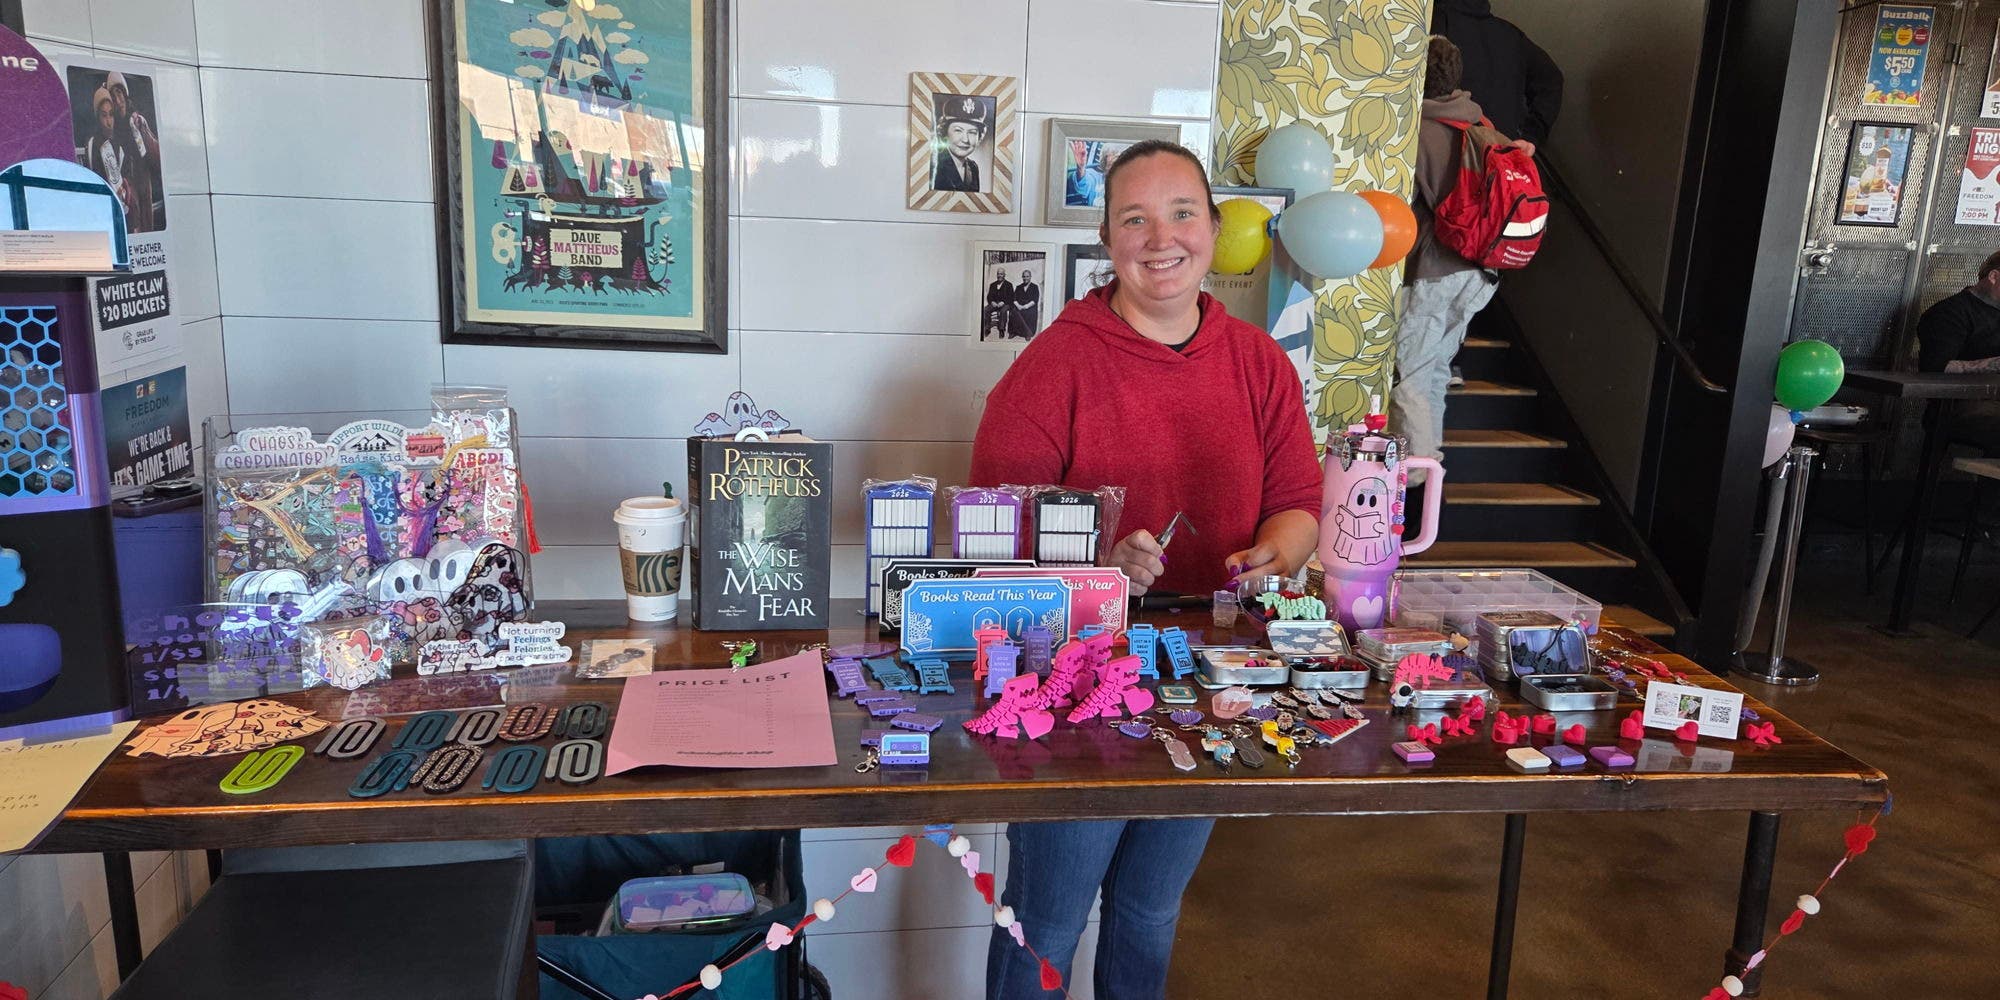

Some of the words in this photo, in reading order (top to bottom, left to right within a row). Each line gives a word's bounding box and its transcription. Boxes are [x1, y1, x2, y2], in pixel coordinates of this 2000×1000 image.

[1882, 10, 1930, 21] BuzzBallz
[1975, 131, 2000, 144] TRI
[1974, 142, 2000, 155] NIG
[571, 231, 601, 244] DAVE
[554, 242, 619, 256] MATTHEWS
[135, 254, 166, 267] WELCOME
[570, 254, 603, 266] BAND
[101, 282, 136, 302] WHITE
[137, 277, 163, 296] CLAW
[1229, 280, 1254, 289] EVENT
[103, 304, 120, 322] $20
[121, 295, 167, 318] BUCKETS
[126, 395, 169, 420] FREEDOM
[128, 434, 149, 457] WE'RE
[149, 427, 167, 449] BACK
[166, 425, 172, 442] &
[331, 423, 369, 446] UPPORT
[249, 435, 295, 452] CHAOS
[114, 465, 135, 486] IT'S
[136, 451, 166, 486] GAME
[166, 441, 190, 474] TIME
[225, 451, 323, 470] COORDINATOR
[340, 454, 376, 464] Raise
[379, 453, 402, 463] Kid
[724, 448, 814, 477] PATRICK
[709, 473, 821, 501] ROTHFUSS
[718, 550, 737, 560] THE
[733, 542, 800, 569] WISE
[722, 567, 804, 595] MAN'S
[896, 569, 935, 581] Books
[1086, 579, 1115, 592] Year
[919, 590, 959, 603] Books
[962, 590, 995, 602] Read
[997, 588, 1025, 601] This
[1027, 588, 1057, 602] Year
[759, 593, 816, 621] FEAR
[524, 627, 561, 636] turning
[514, 635, 551, 644] Feelings
[658, 679, 729, 687] PRICE
[742, 672, 791, 684] LIST
